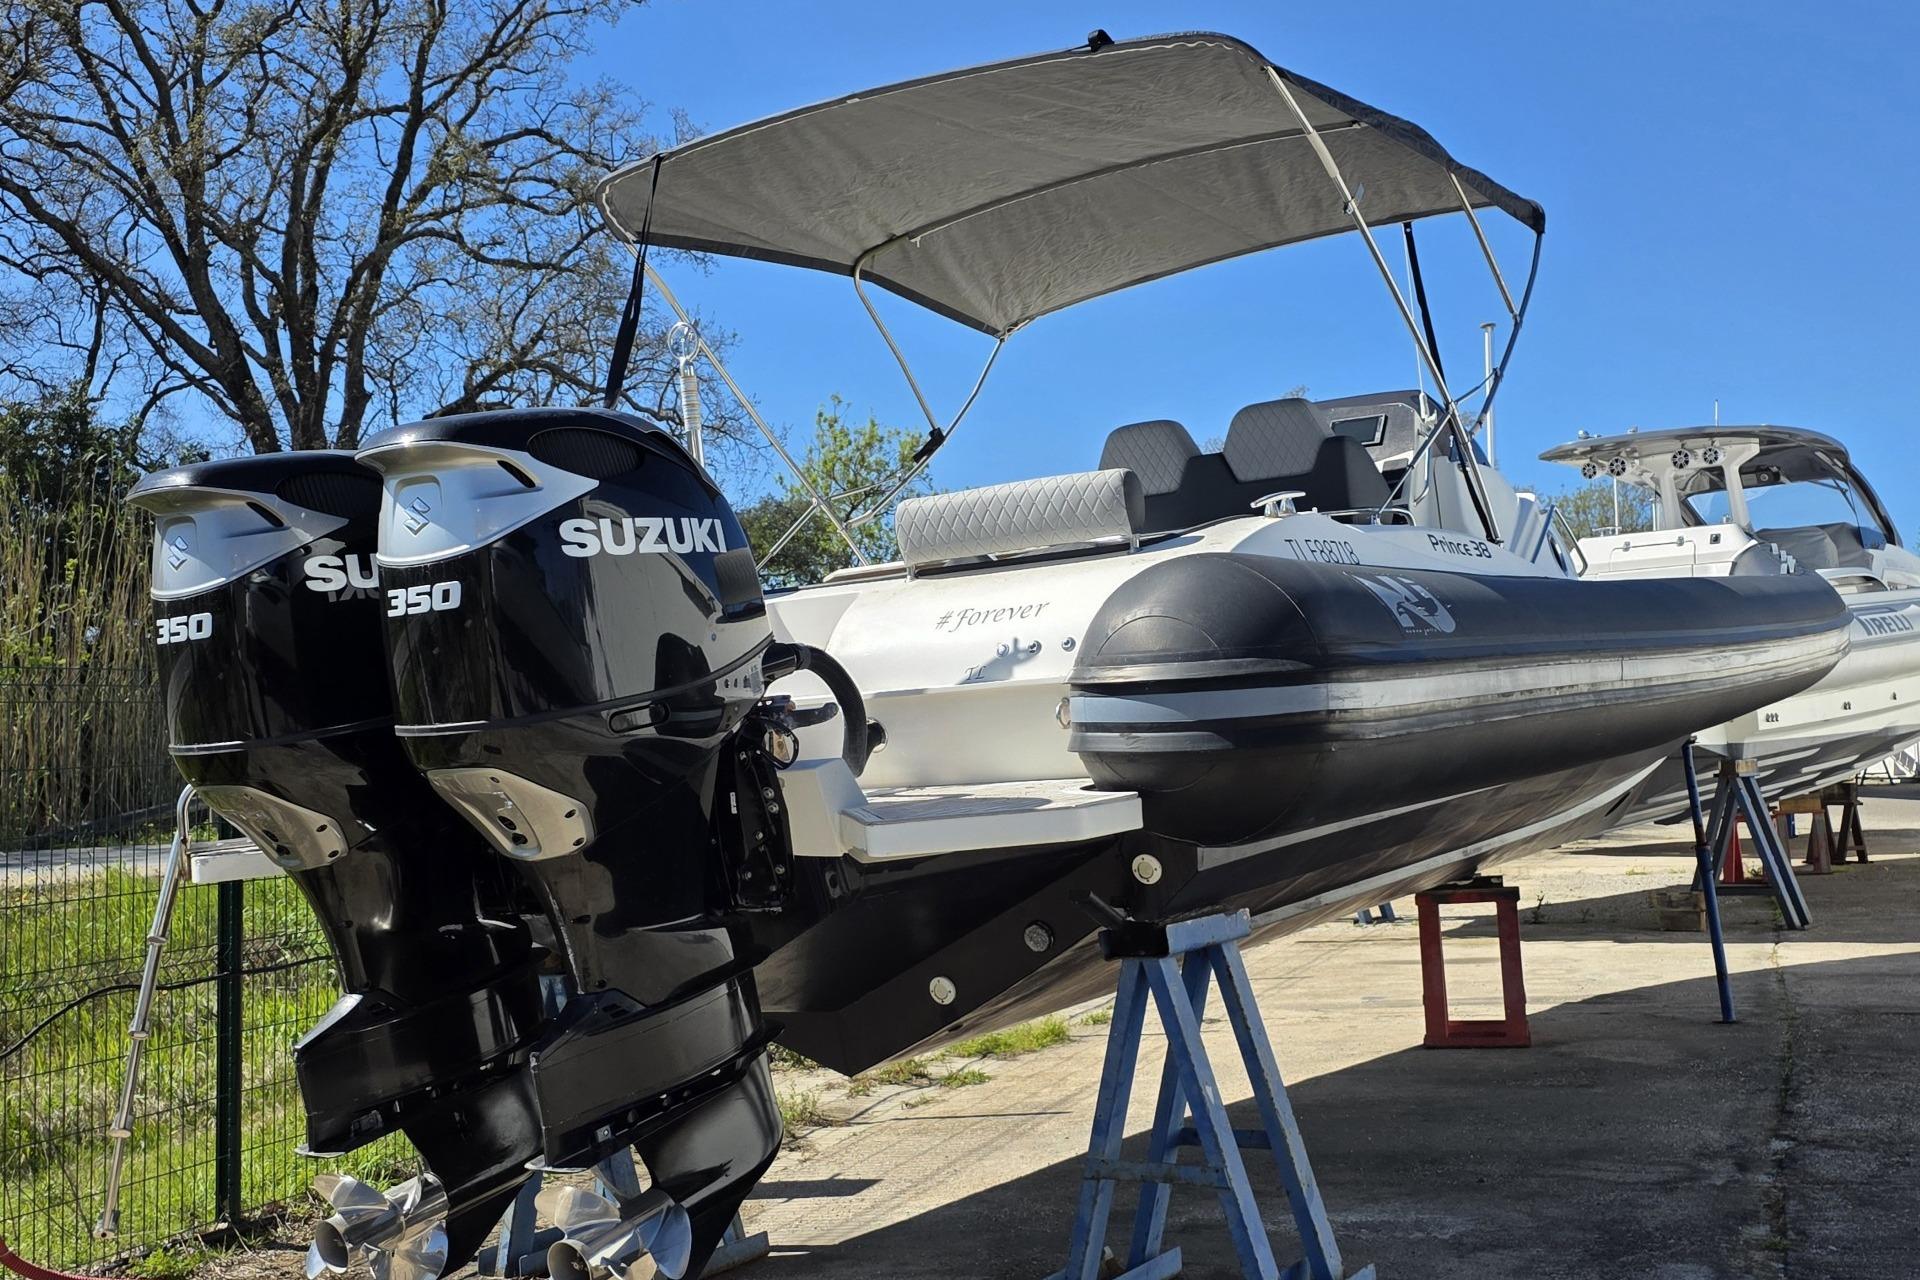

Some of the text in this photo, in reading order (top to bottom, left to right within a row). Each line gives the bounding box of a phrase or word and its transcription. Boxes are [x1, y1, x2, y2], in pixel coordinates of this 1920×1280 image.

[560, 516, 728, 558] SUZUKI
[1427, 533, 1492, 559] Prince 38
[387, 580, 462, 618] 350
[156, 612, 213, 645] 350
[935, 601, 1050, 633] #Forever
